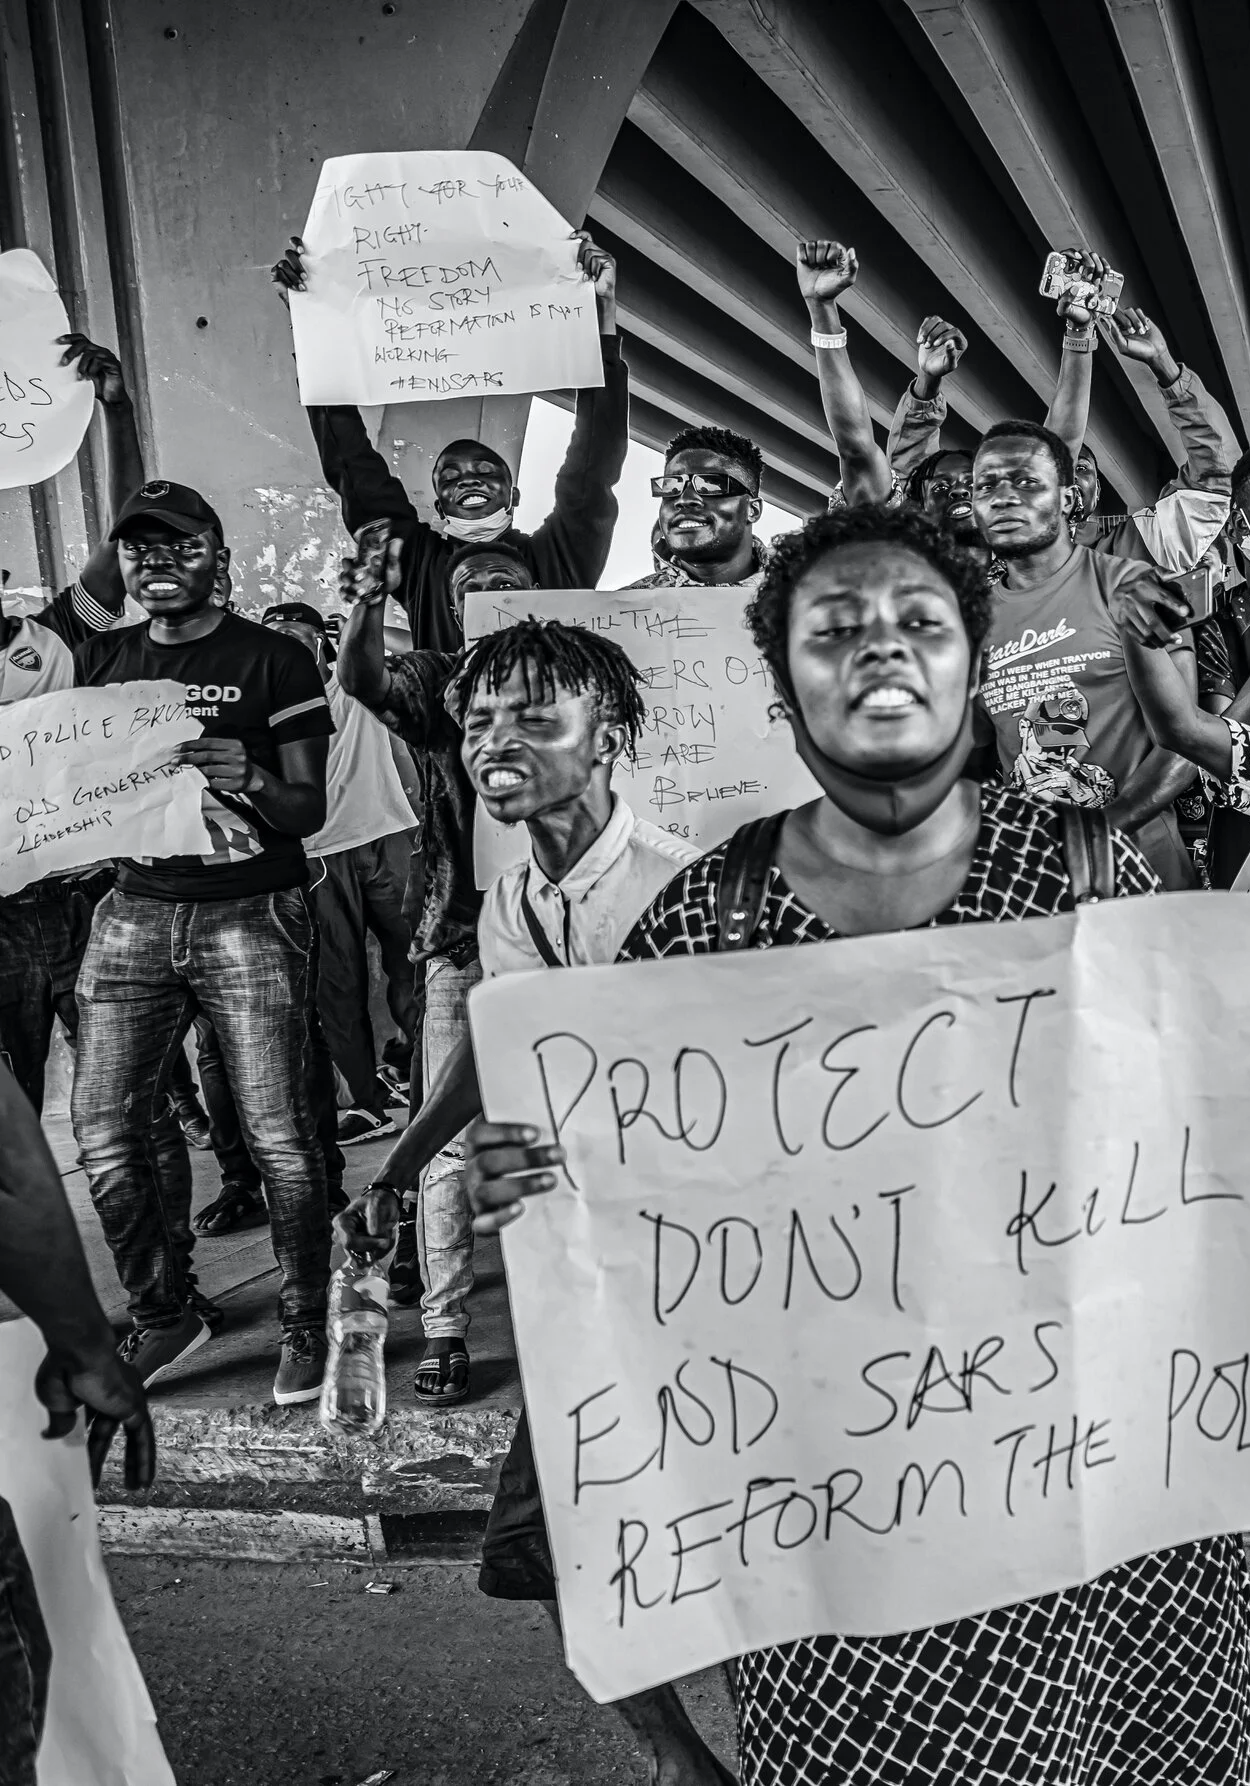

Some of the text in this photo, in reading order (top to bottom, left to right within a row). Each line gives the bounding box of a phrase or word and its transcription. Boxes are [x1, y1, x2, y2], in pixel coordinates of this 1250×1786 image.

[418, 180, 480, 205] FOR
[357, 257, 502, 290] FREEDOM
[428, 287, 490, 311] STORY
[374, 346, 460, 364] WORKING
[620, 608, 716, 639] THE
[997, 676, 1017, 687] WAS
[1018, 673, 1028, 682] IN
[1030, 670, 1050, 680] THE
[1050, 663, 1087, 676] STREET
[1006, 664, 1034, 675] WEEP
[1034, 658, 1060, 670] WHEN
[1062, 651, 1111, 664] TRAYVON
[185, 684, 242, 702] GOD
[983, 687, 1004, 700] WHEN
[1005, 674, 1072, 693] GANGBANGING
[1005, 691, 1020, 701] ME
[23, 714, 116, 767] POLICE
[660, 743, 717, 767] ARE
[16, 798, 60, 824] OLD
[533, 989, 1057, 1191] PROTECT
[638, 1185, 915, 1326] DON'T
[566, 1321, 1063, 1505] END SARS
[609, 1457, 968, 1629] REFORM
[993, 1417, 1116, 1518] THE
